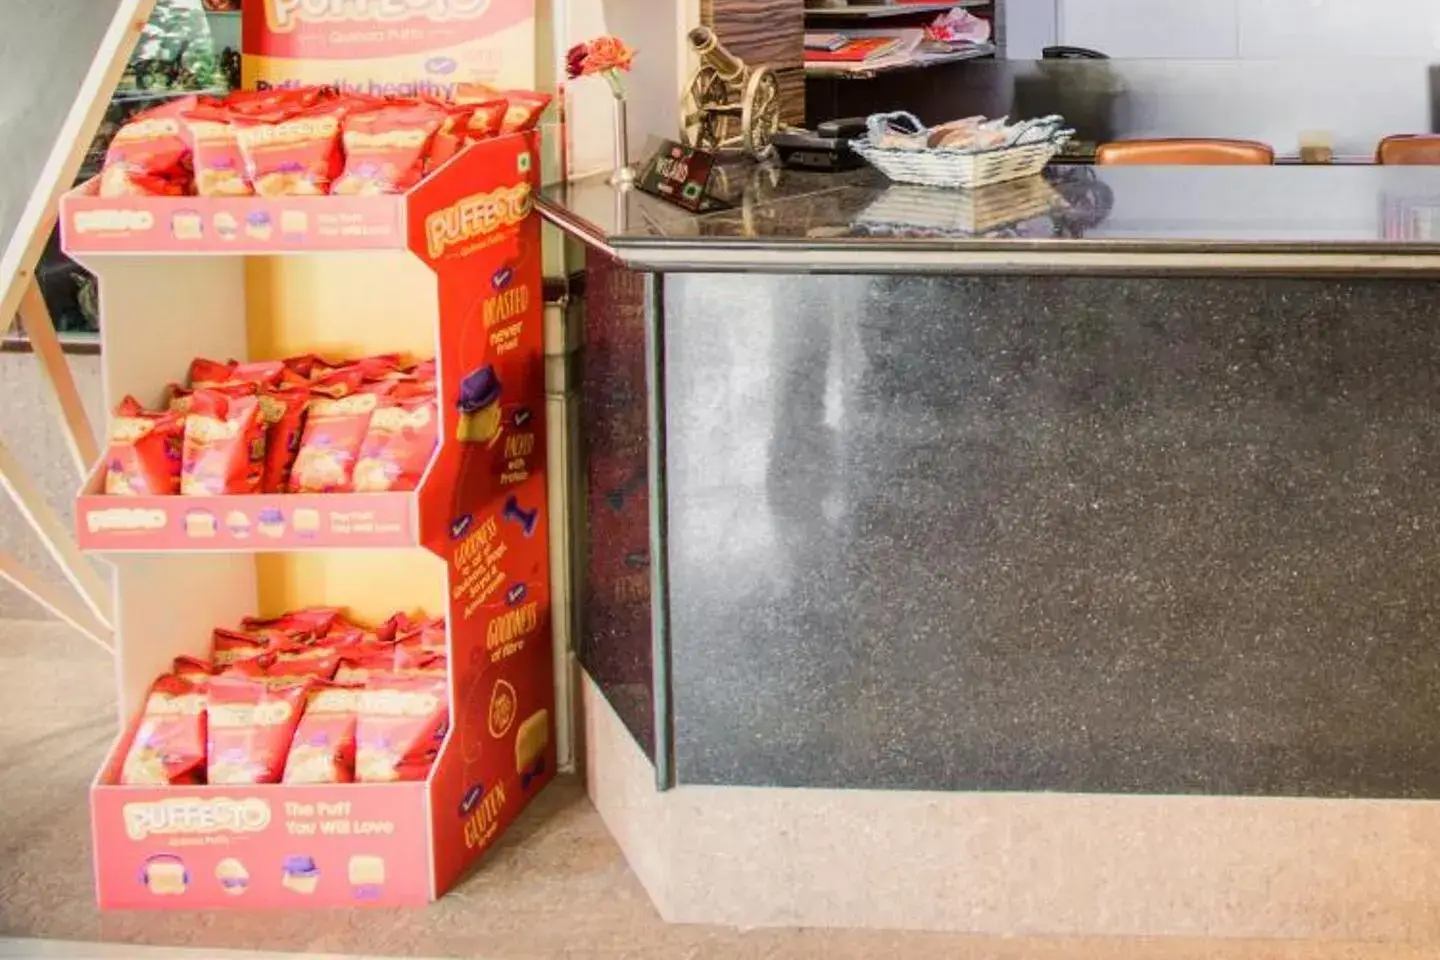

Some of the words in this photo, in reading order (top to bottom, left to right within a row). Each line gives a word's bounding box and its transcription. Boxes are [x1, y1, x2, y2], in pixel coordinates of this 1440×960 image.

[284, 801, 314, 817] The
[317, 801, 352, 817] Puff
[126, 798, 270, 839] PUFFECTO
[285, 821, 317, 836] You
[320, 820, 351, 835] Will
[353, 821, 394, 835] Love
